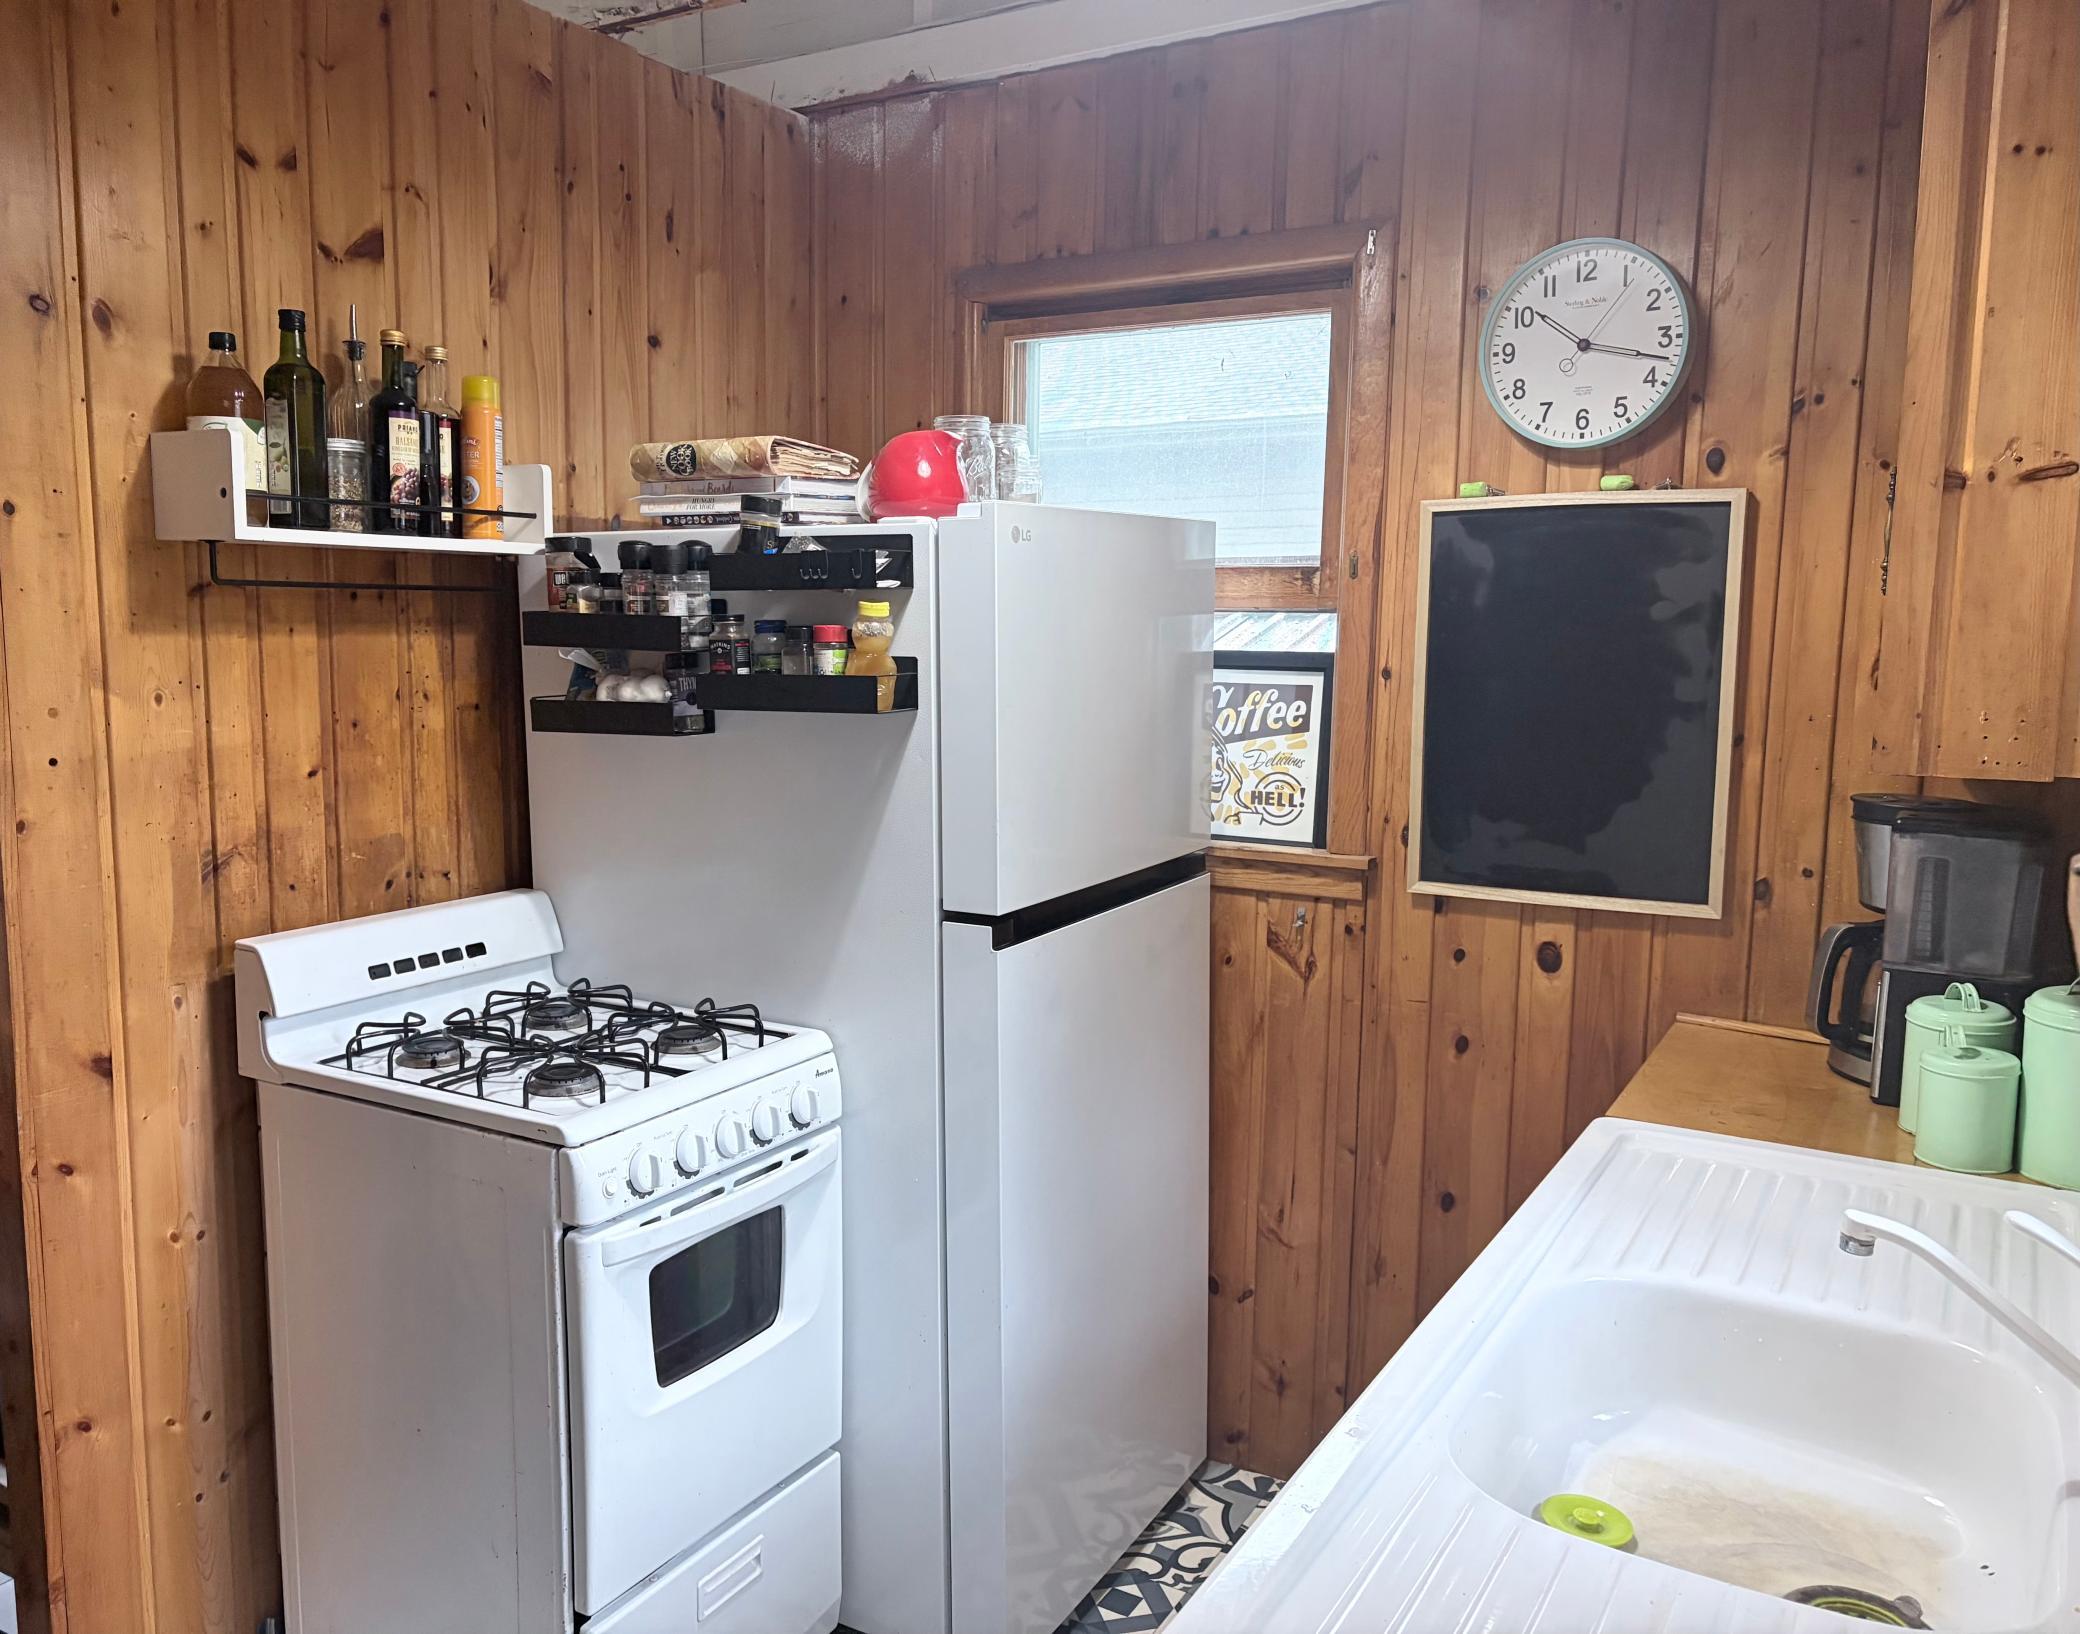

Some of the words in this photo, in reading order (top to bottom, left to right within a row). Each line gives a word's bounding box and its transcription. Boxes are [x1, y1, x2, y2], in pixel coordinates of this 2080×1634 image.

[1576, 258, 1598, 283] 12
[1623, 264, 1629, 287] 1
[1543, 274, 1557, 298] 11
[1645, 288, 1662, 312] 2
[1514, 306, 1535, 329] 10
[1657, 326, 1673, 348] 3
[1501, 342, 1516, 364] 9
[1642, 366, 1658, 388] 4
[1512, 378, 1526, 400] 8
[1539, 401, 1554, 423] 7
[1613, 396, 1628, 418] 5
[1575, 408, 1590, 431] 6
[1021, 529, 1032, 541] LG
[1242, 749, 1306, 771] Delicious
[1250, 787, 1306, 808] HELL!
